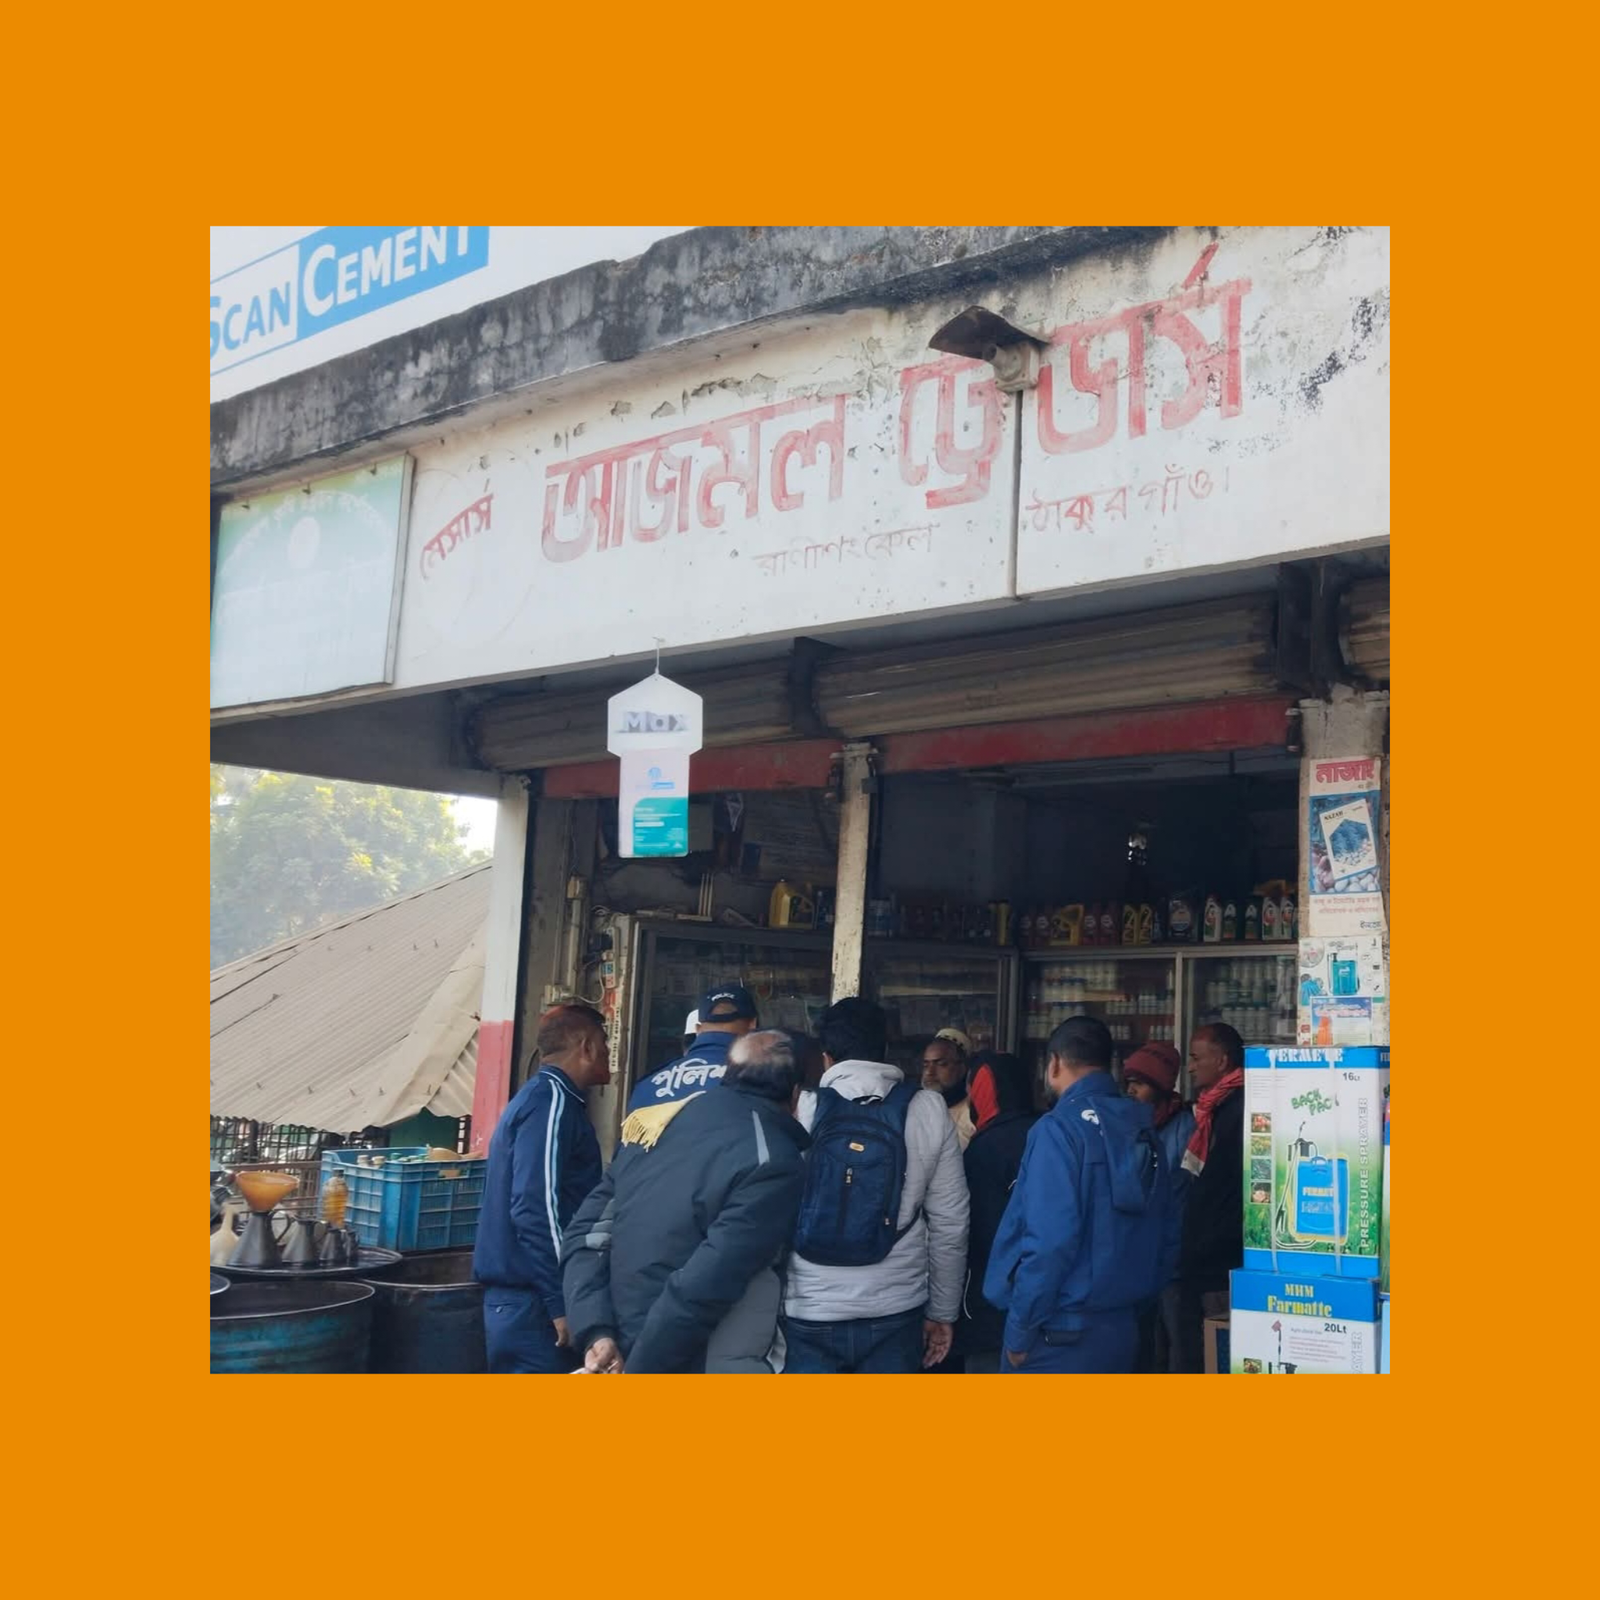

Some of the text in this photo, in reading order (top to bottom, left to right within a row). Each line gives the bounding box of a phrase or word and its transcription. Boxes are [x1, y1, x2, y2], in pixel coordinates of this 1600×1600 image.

[303, 226, 468, 317] CEMENT
[541, 394, 847, 563] আজমল
[1309, 1094, 1339, 1116] PAC
[1358, 1098, 1370, 1248] PRESSURE SPRAYER
[1267, 1294, 1333, 1318] Farmatte
[1285, 1283, 1314, 1298] MHM
[1324, 1322, 1347, 1334] 20Lt
[1351, 1331, 1363, 1374] AYER
